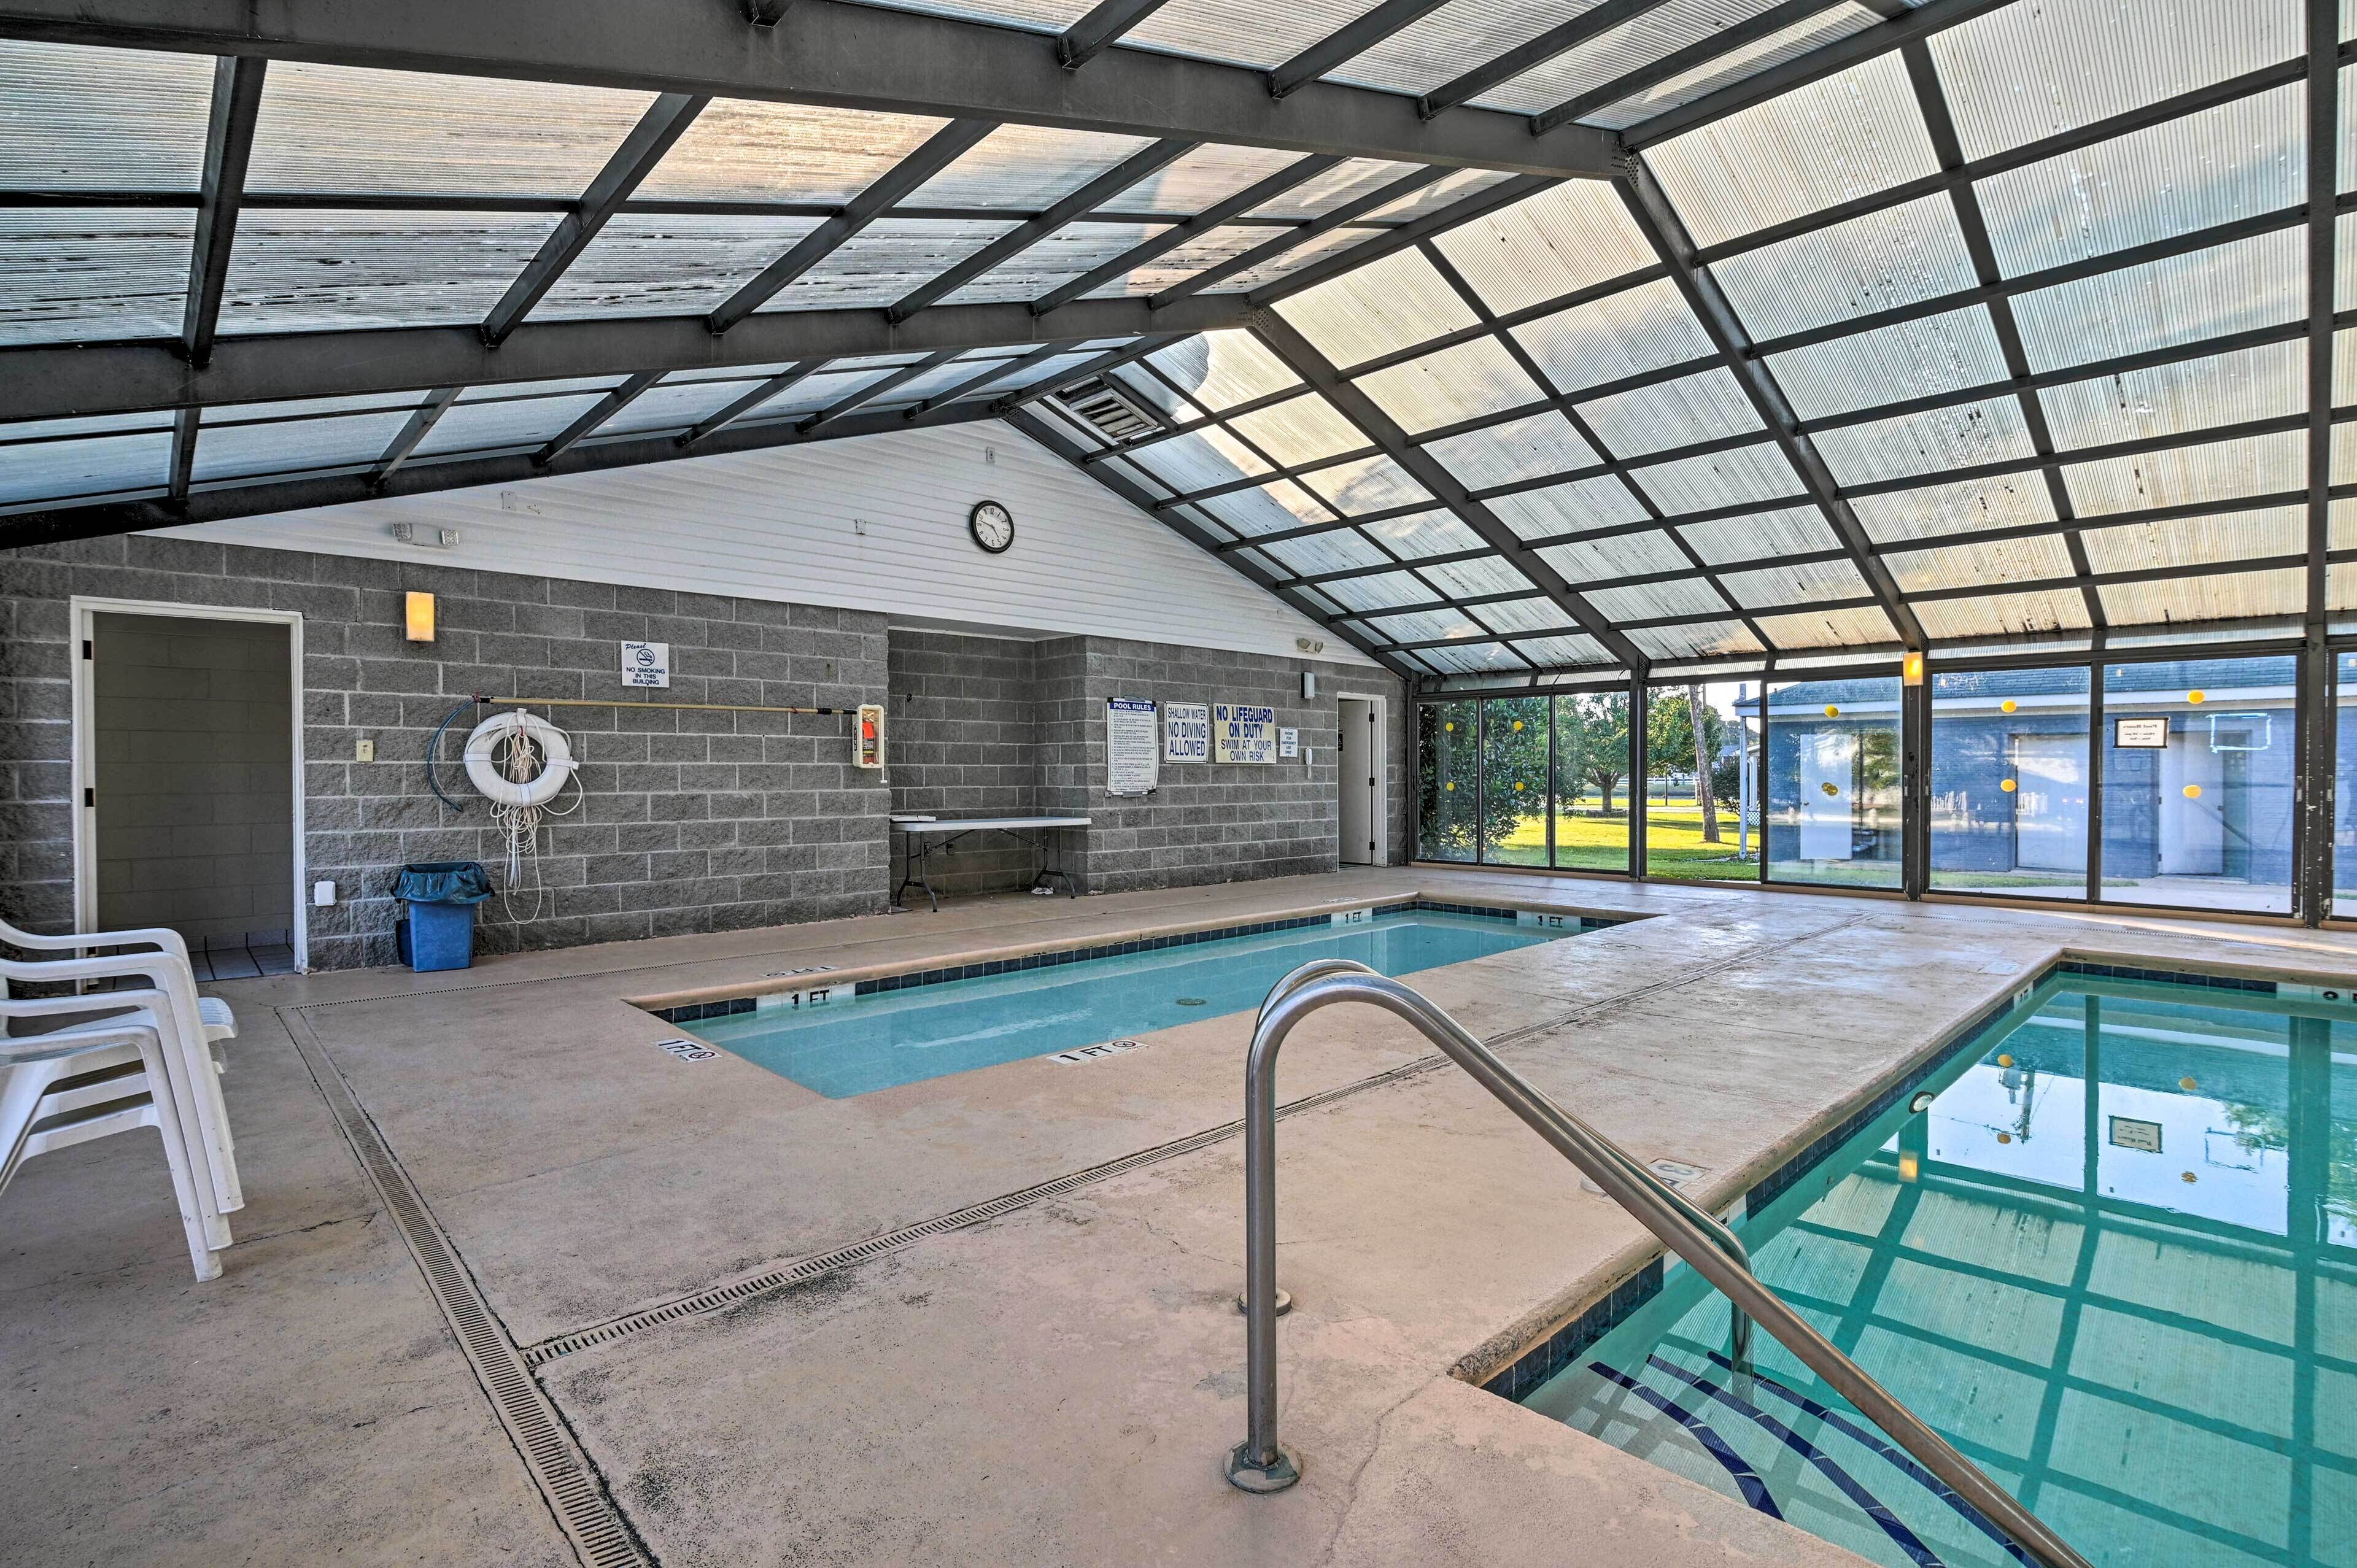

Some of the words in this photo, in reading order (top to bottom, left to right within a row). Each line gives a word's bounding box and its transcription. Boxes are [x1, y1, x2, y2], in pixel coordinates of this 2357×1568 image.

[1168, 707, 1190, 719] SHALLOW
[1191, 709, 1206, 720] WATER
[1217, 706, 1228, 721] NO
[1232, 706, 1272, 723] LIFEGUARD
[1168, 721, 1179, 738] NO
[1182, 722, 1206, 739] DIVING
[1229, 722, 1240, 738] ON
[1244, 724, 1263, 738] DUTY
[1169, 740, 1206, 756] ALLOWED
[1221, 739, 1239, 750] SWIM
[1242, 740, 1251, 750] AT
[1254, 740, 1272, 751] YOUR
[1230, 751, 1246, 761] OWN
[1249, 751, 1264, 762] RISK
[791, 993, 799, 1005] 1
[810, 989, 830, 1003] FT
[667, 1044, 702, 1052] FT
[1080, 1045, 1112, 1057] FT
